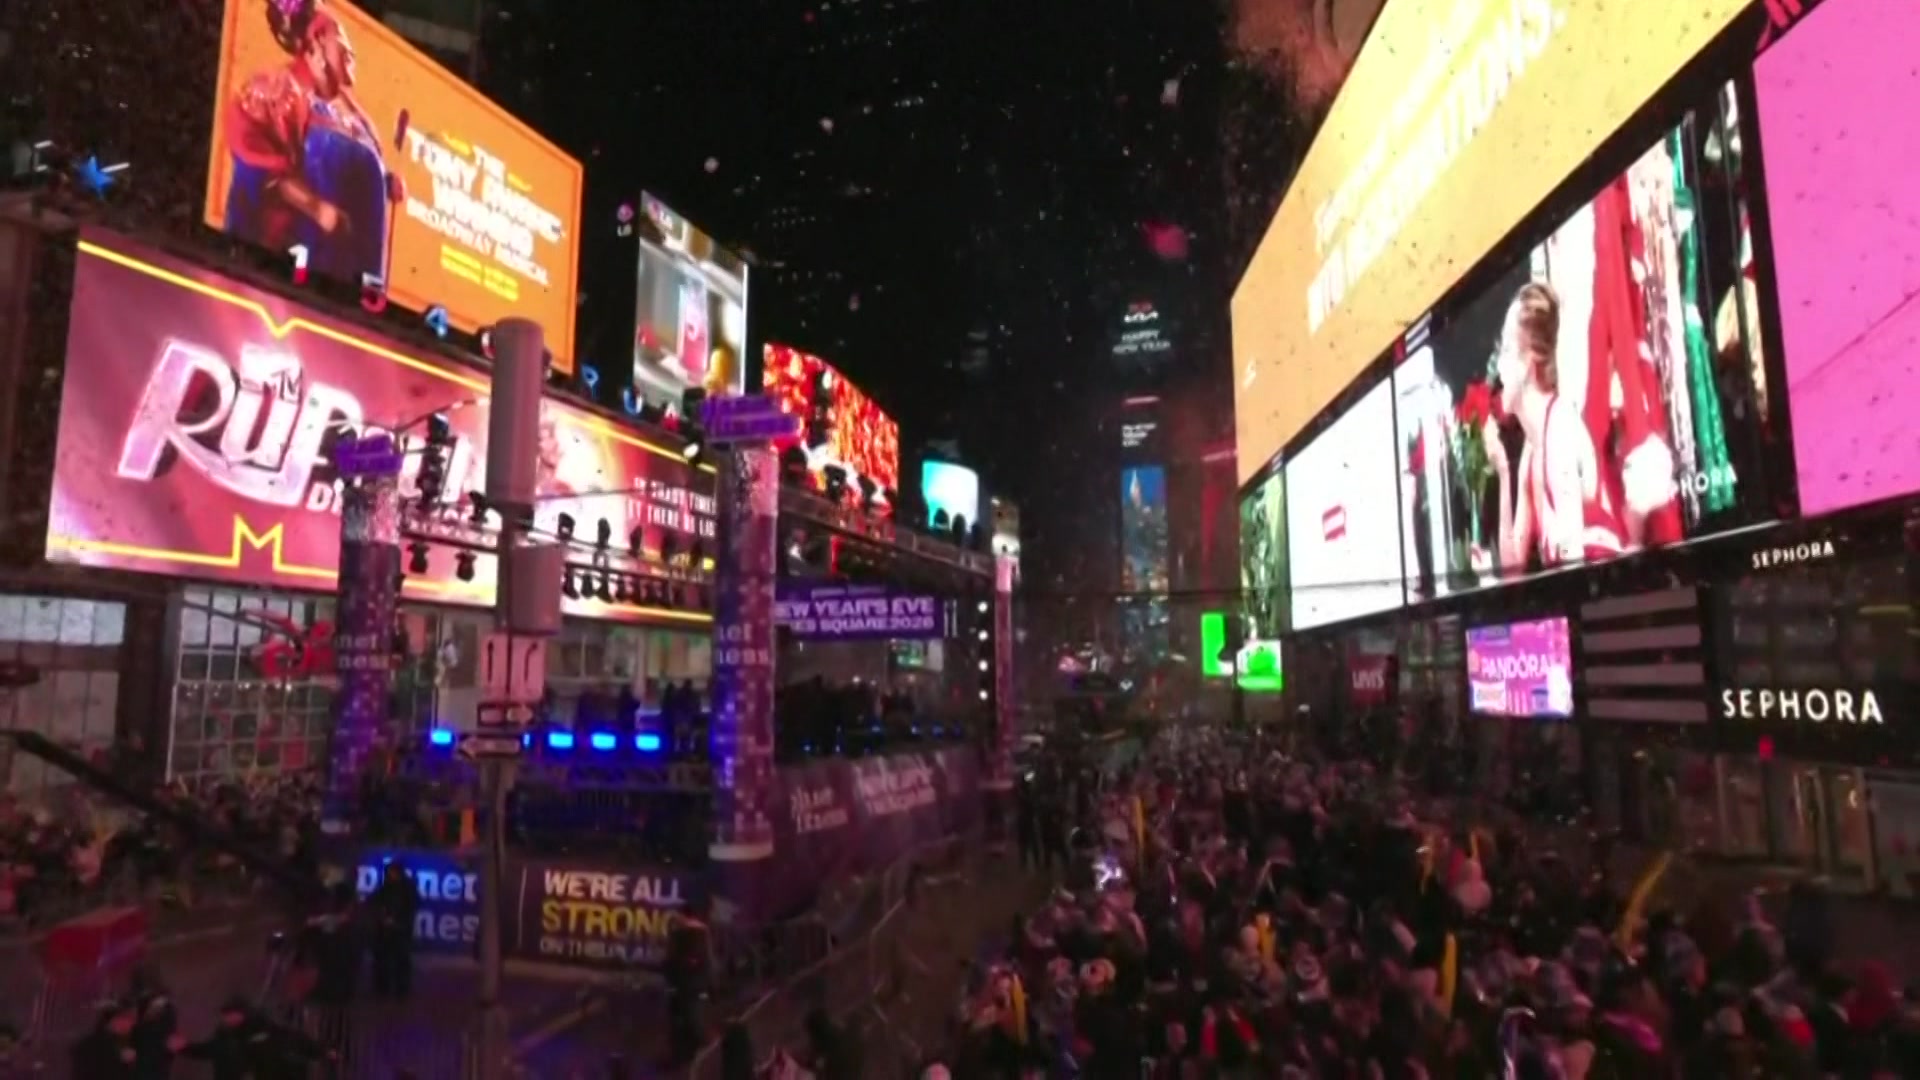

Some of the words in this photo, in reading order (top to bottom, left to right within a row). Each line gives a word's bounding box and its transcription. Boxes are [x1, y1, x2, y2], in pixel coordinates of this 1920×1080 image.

[1752, 540, 1835, 569] SEPHORA
[892, 597, 935, 615] EVE
[820, 618, 887, 634] SQUARE
[1481, 649, 1551, 679] PANDORA
[1722, 688, 1883, 724] SEPHORA
[632, 876, 686, 906] ALL
